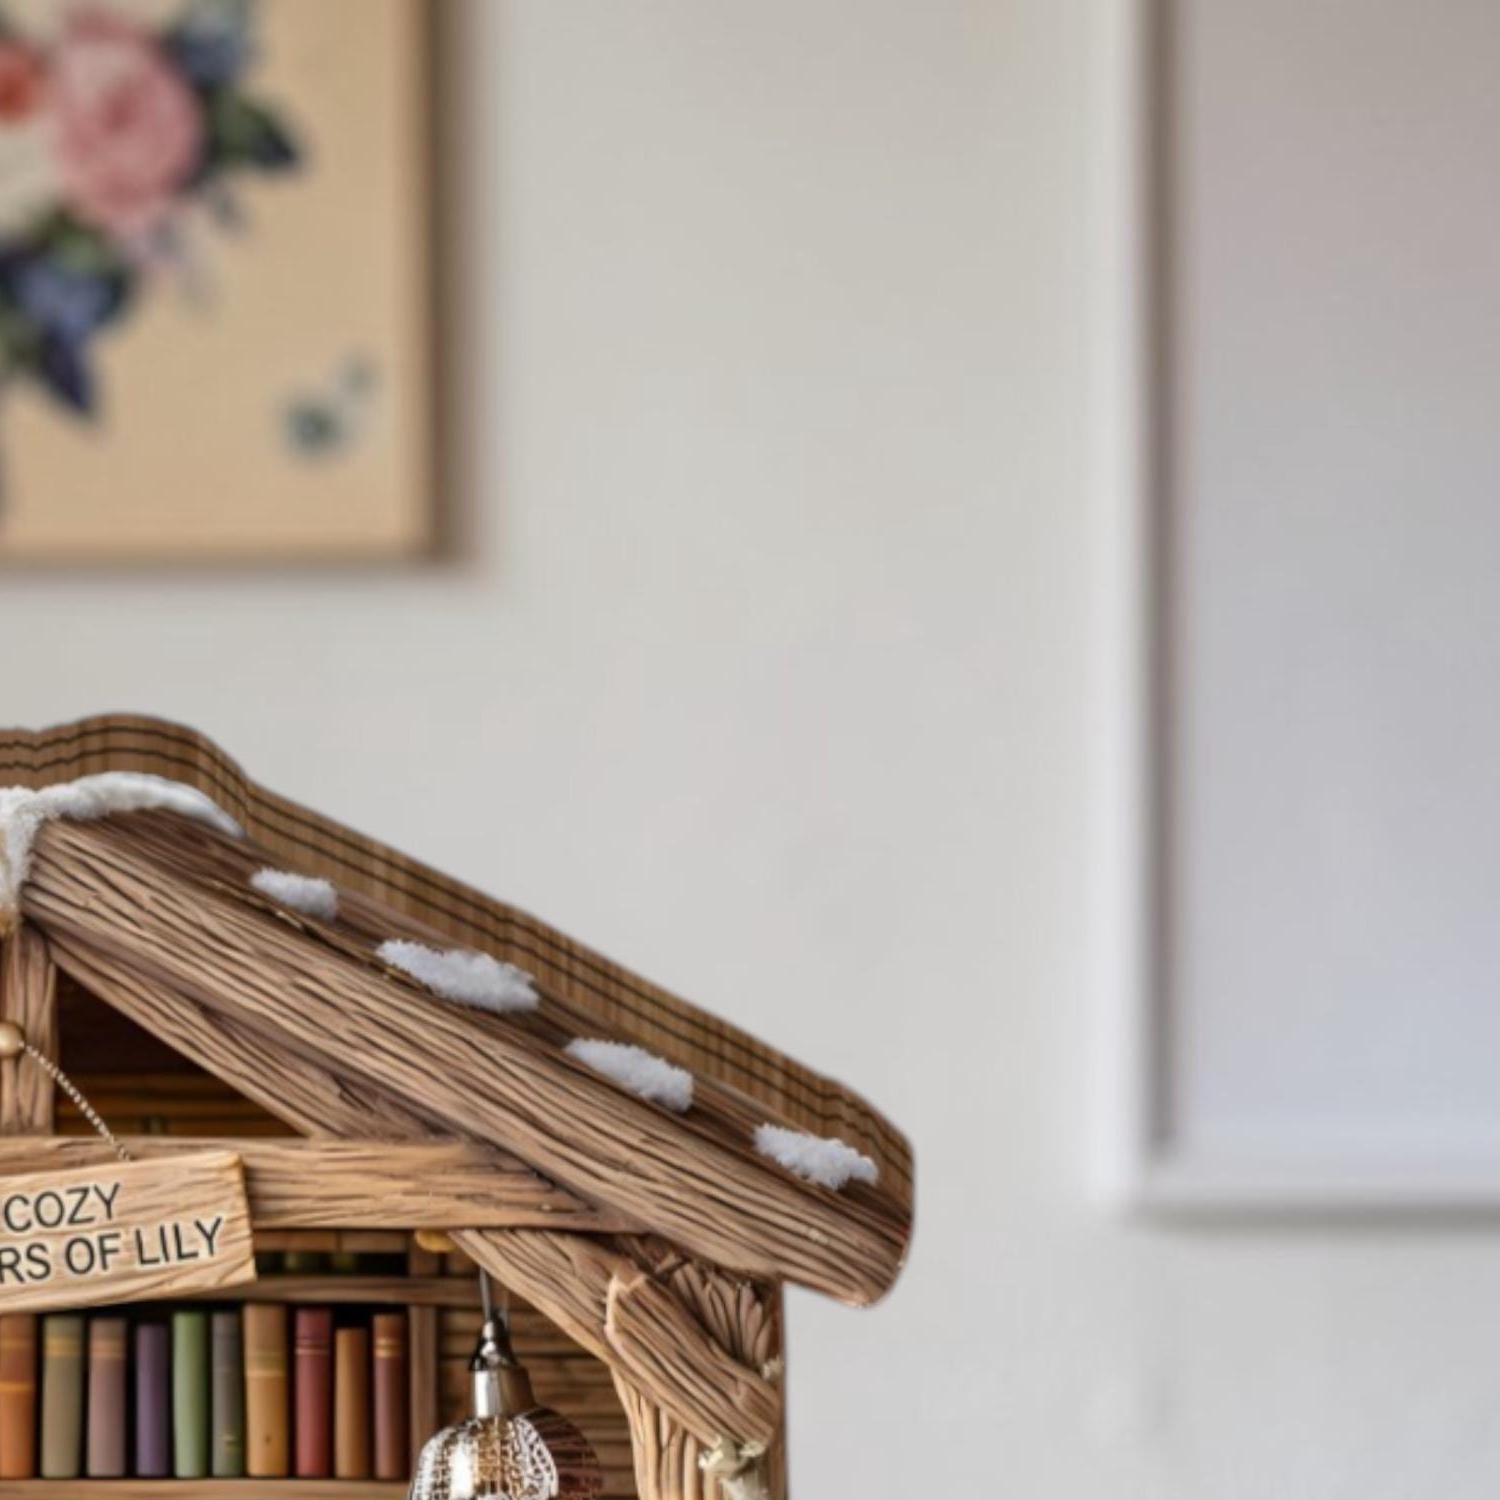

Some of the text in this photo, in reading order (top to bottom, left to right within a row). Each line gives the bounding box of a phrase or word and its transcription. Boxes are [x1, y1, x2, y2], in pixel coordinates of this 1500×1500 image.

[3, 1183, 121, 1233] COZY
[64, 1232, 122, 1276] OF
[135, 1216, 223, 1266] LILY
